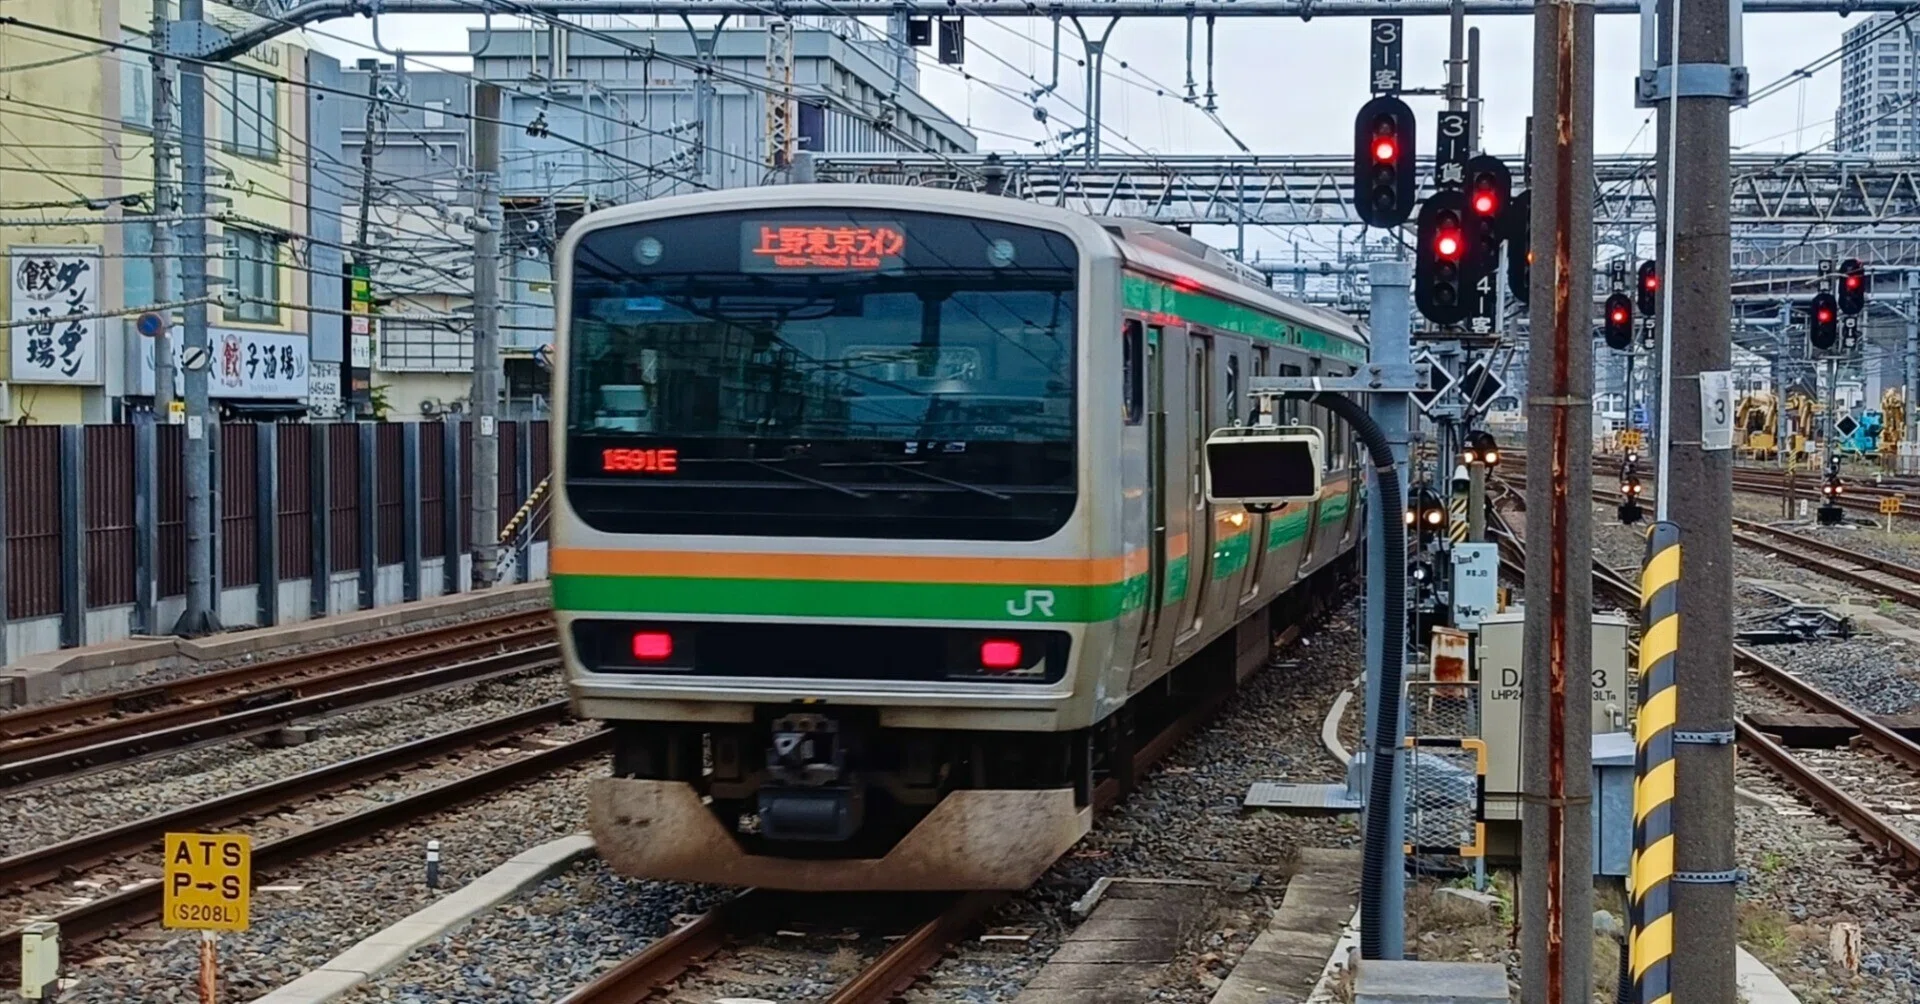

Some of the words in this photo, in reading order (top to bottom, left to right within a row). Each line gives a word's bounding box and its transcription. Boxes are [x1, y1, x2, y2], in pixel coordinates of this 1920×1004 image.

[752, 226, 904, 255] 上野東京ライン
[26, 307, 57, 369] 酒場
[1714, 399, 1726, 425] 3
[602, 449, 678, 471] 1591E
[1006, 590, 1055, 617] JR
[1502, 668, 1523, 687] D
[174, 841, 241, 867] ATS
[173, 872, 192, 897] P
[221, 875, 240, 899] S
[172, 904, 241, 923] (S208L)
